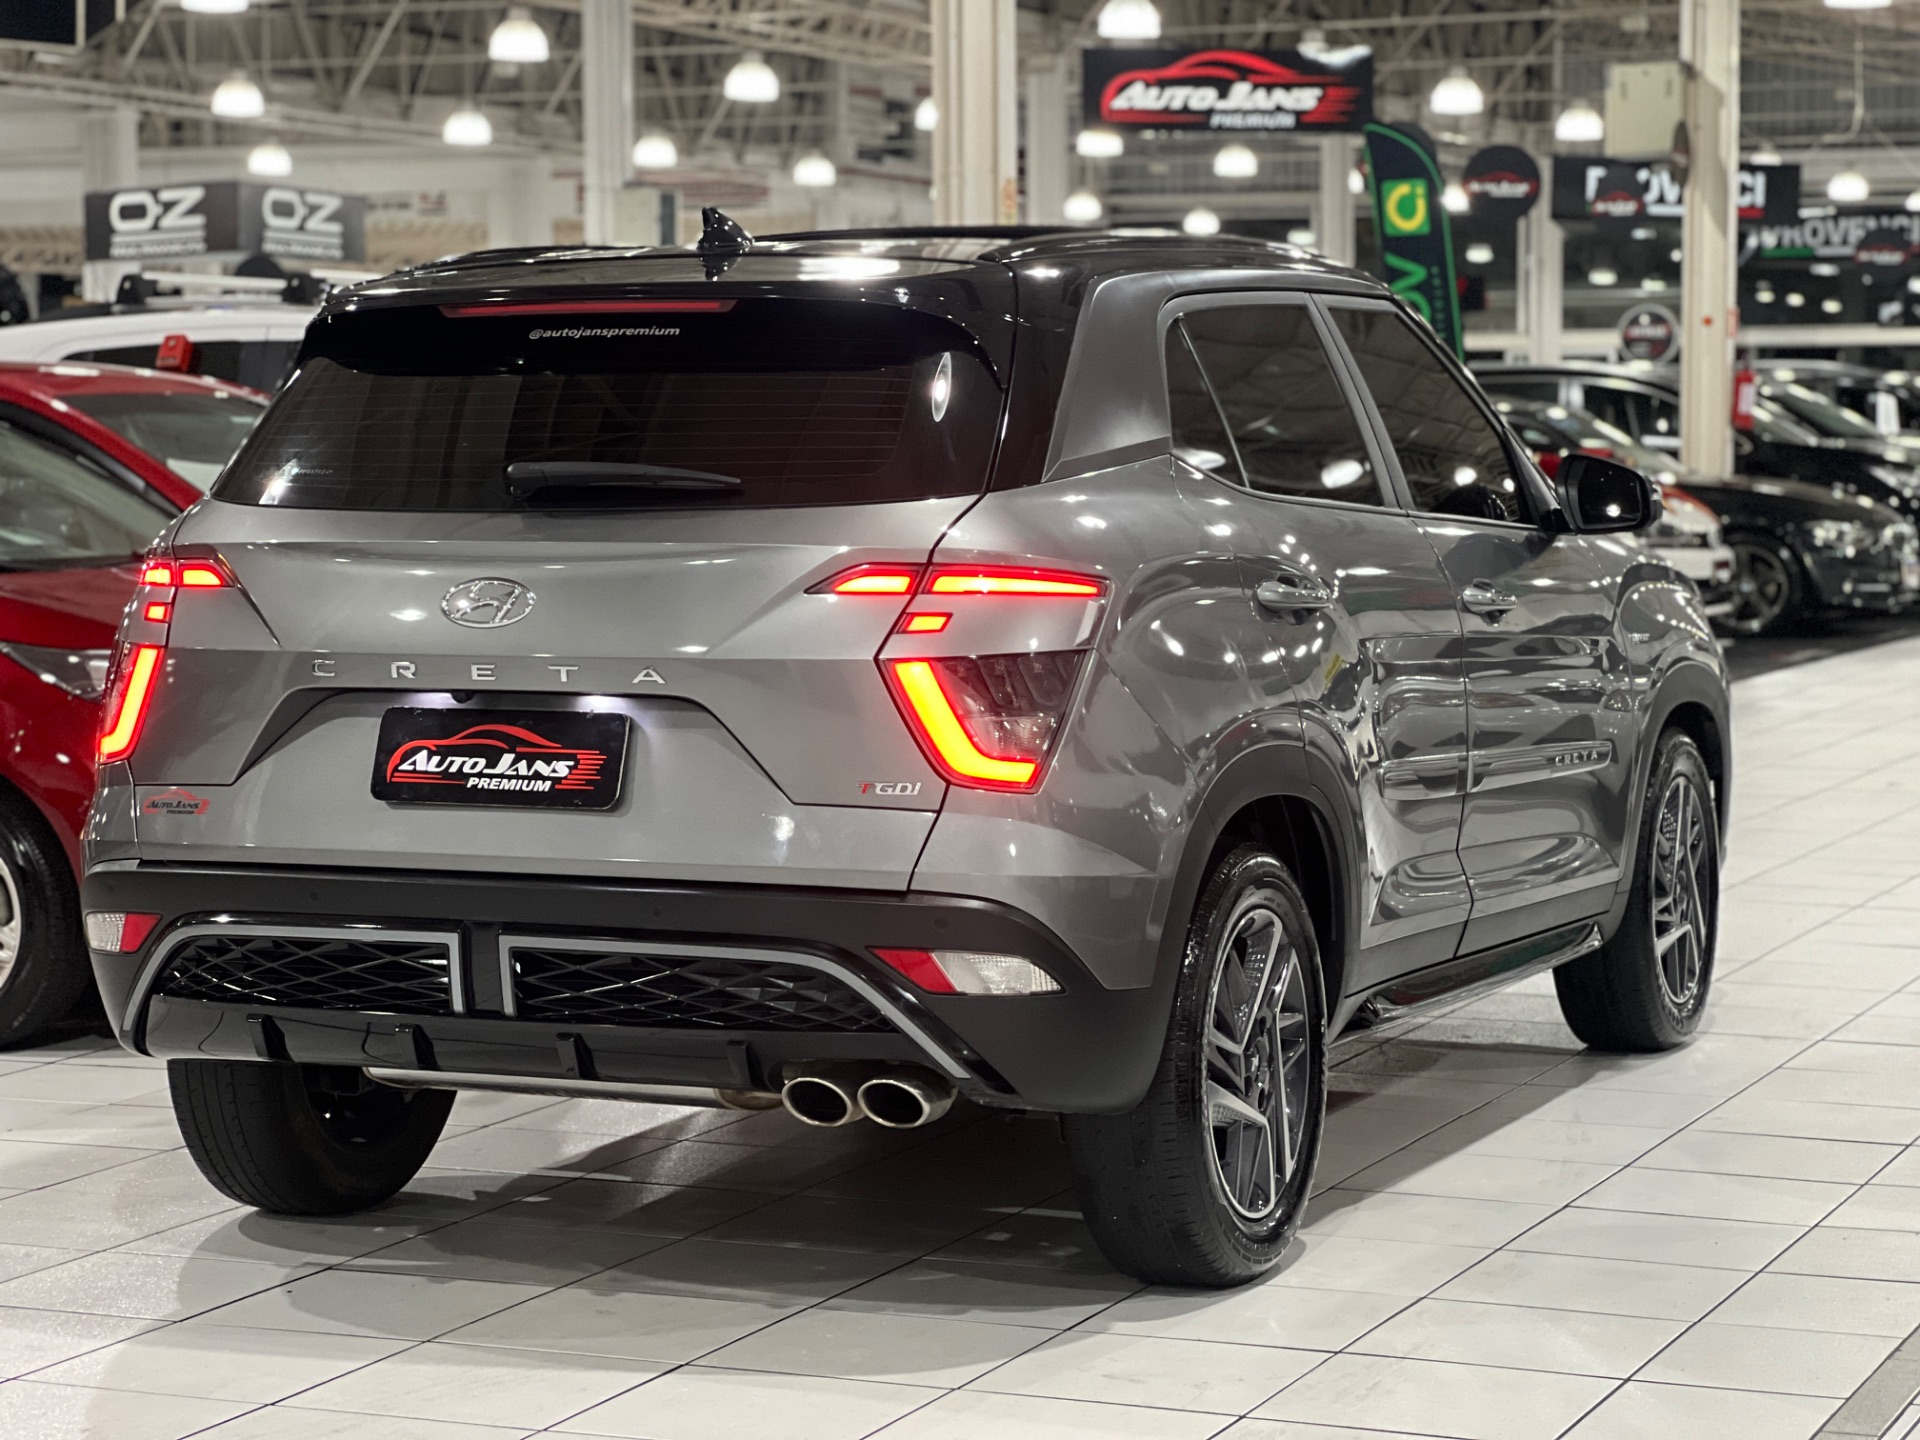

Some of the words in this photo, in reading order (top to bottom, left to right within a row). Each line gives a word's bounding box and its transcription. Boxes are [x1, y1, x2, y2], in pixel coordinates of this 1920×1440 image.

[109, 186, 206, 232] OZ
[261, 188, 344, 233] OZ
[529, 326, 680, 339] @autojanspremium
[311, 659, 666, 685] CRETA
[1555, 750, 1598, 767] CRETA
[466, 777, 552, 792] PREMIUM
[857, 781, 922, 795] TGDI
